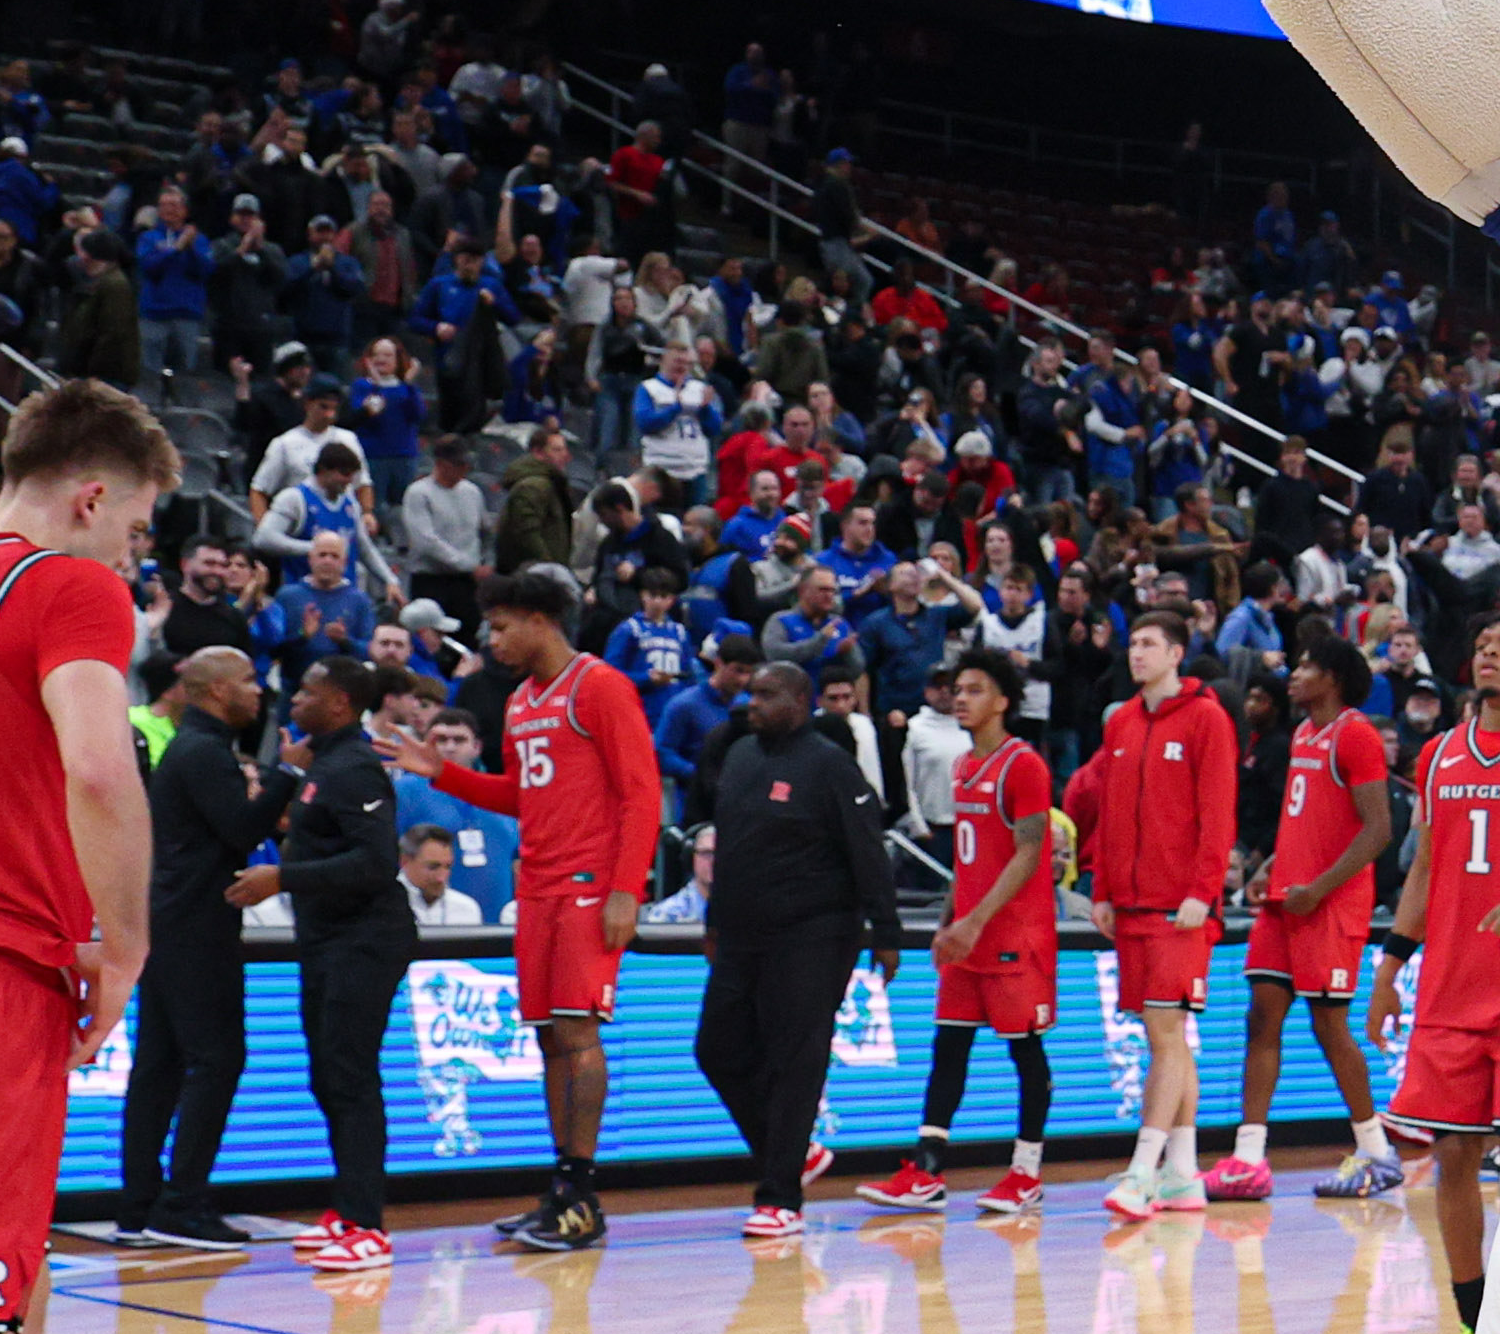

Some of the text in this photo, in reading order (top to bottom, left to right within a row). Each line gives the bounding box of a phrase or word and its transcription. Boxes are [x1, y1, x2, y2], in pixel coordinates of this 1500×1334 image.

[515, 736, 556, 789] 15
[1162, 741, 1184, 762] R
[1287, 773, 1307, 818] 9
[957, 820, 976, 865] 0
[1465, 809, 1491, 874] 1
[454, 981, 491, 1026] We
